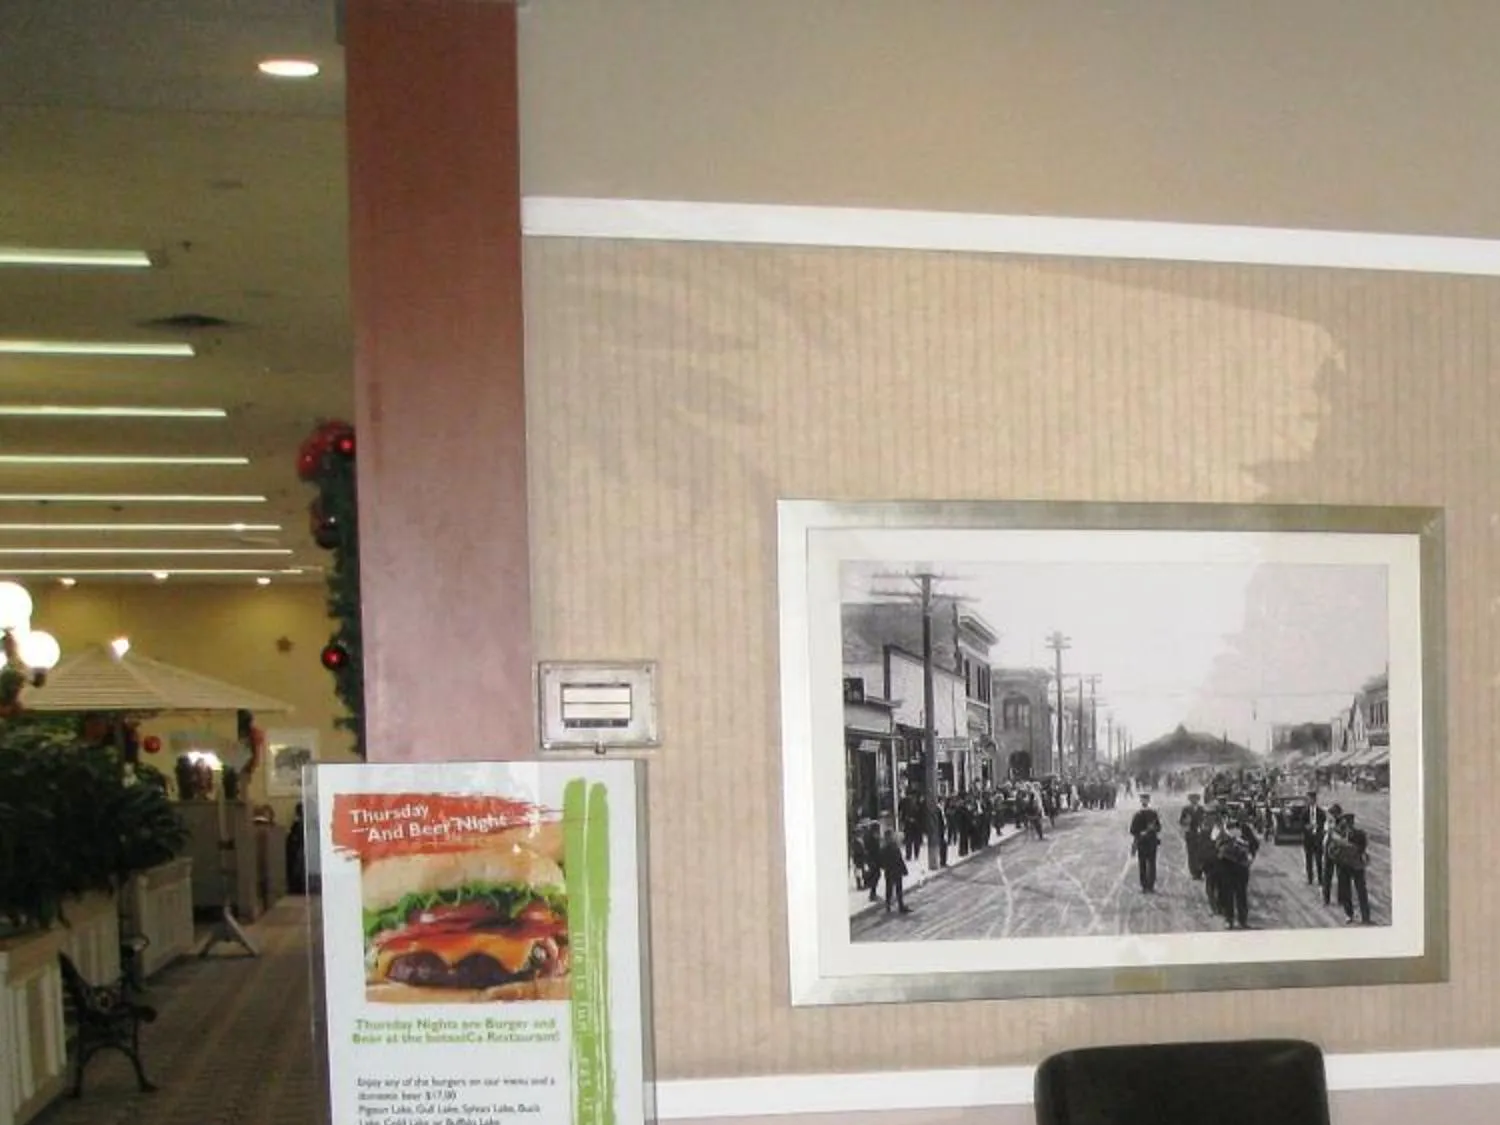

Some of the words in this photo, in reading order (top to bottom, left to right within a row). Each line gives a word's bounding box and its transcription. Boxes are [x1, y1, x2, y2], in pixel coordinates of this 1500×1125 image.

[351, 803, 429, 824] Thursday
[367, 822, 403, 842] And
[355, 1019, 412, 1031] Thursday
[485, 1018, 528, 1031] Burger
